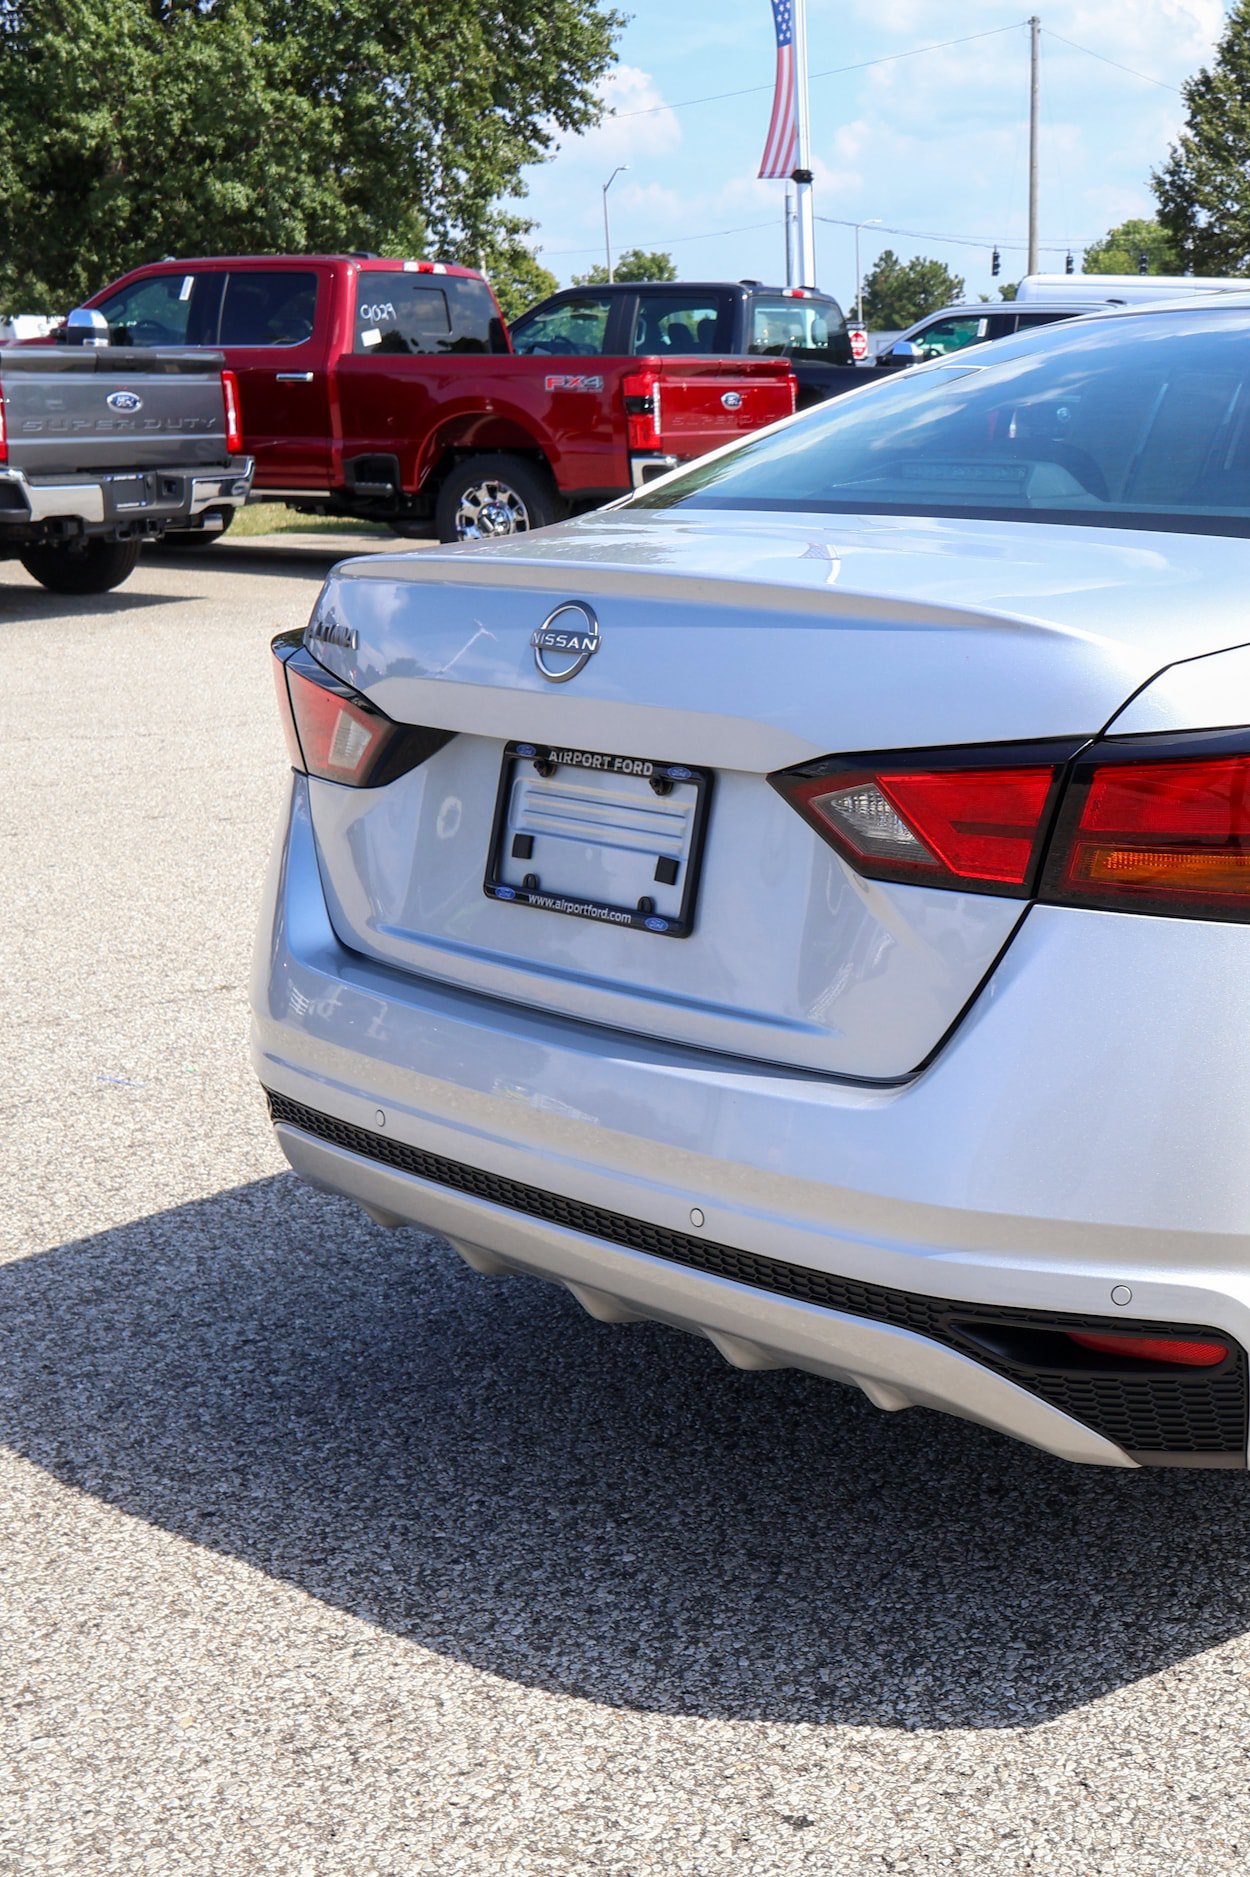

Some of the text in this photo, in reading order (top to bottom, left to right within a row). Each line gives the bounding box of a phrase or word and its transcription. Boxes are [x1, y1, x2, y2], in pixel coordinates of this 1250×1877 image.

[544, 375, 604, 391] FX4
[22, 417, 216, 432] SUPER DUTY
[533, 632, 598, 651] NISSAN
[549, 751, 653, 775] AIRPORT FORD
[528, 894, 632, 923] www.airportford.com
